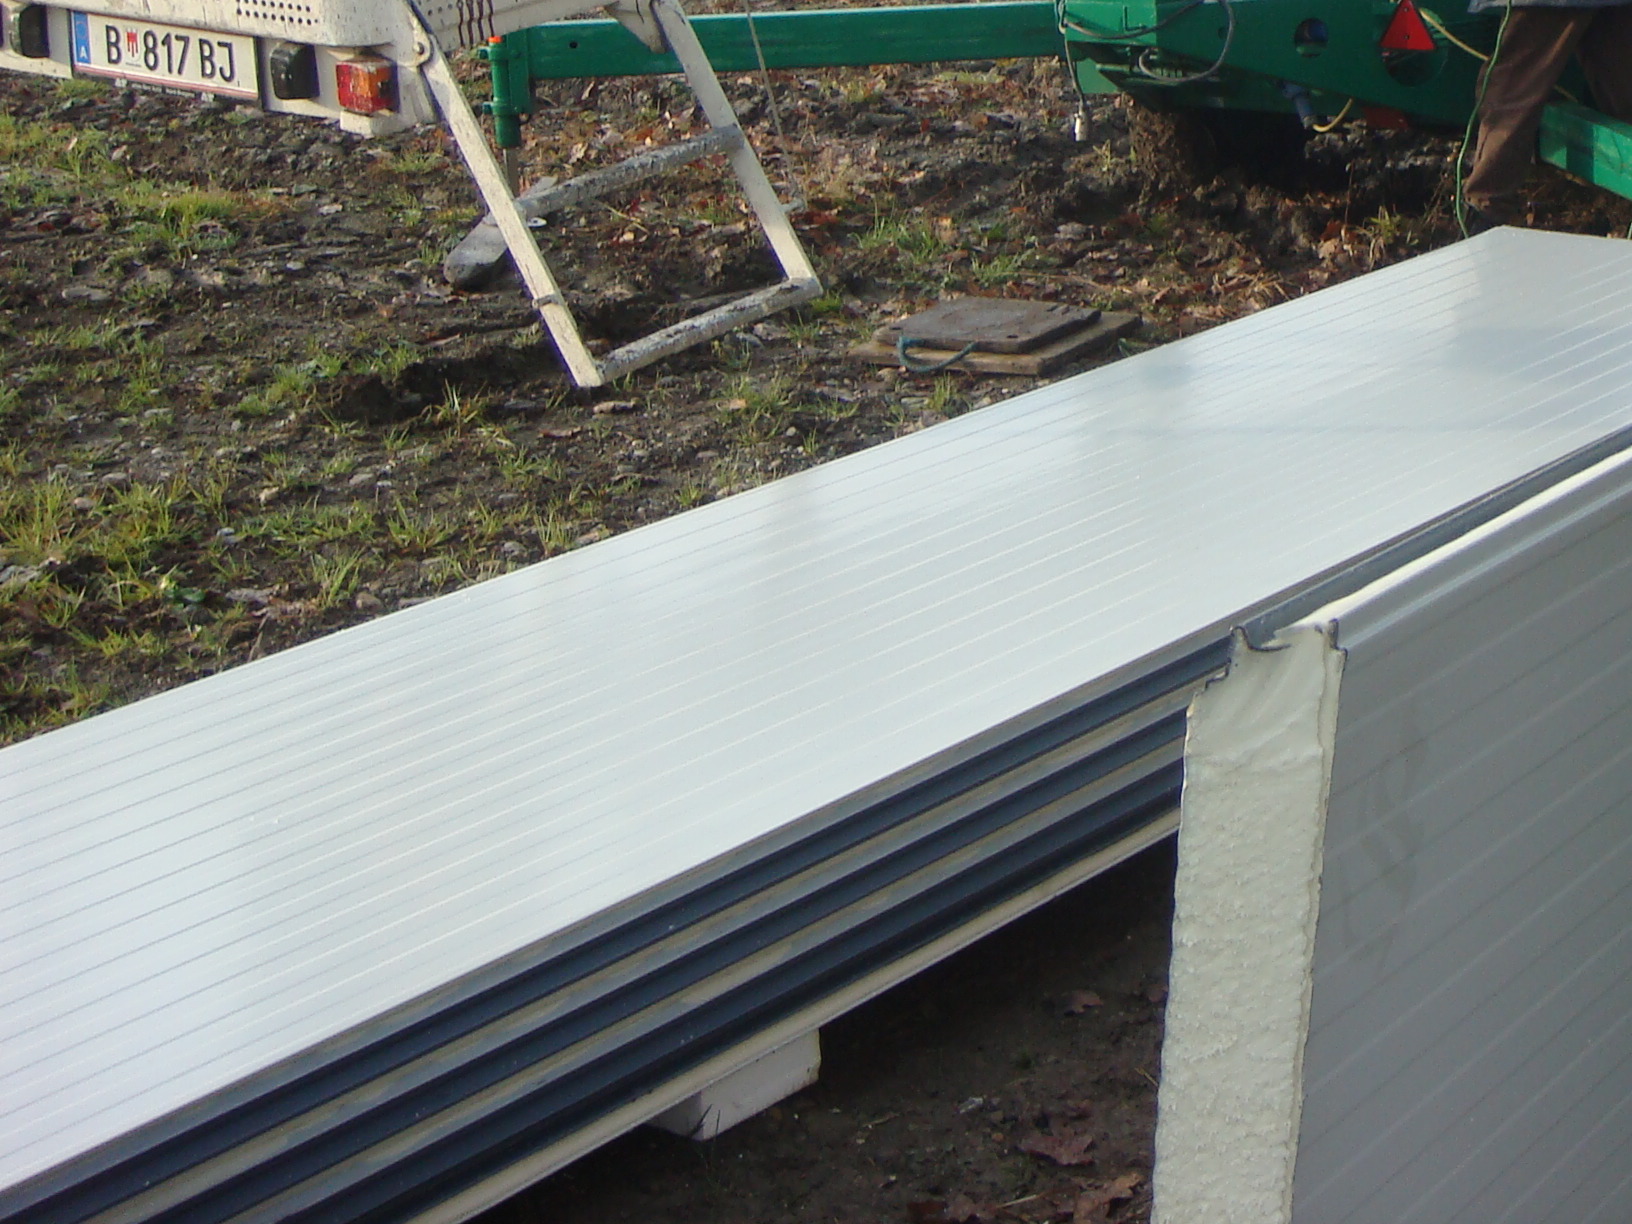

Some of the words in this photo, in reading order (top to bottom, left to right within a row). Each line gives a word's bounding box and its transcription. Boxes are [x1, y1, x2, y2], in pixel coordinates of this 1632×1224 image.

[105, 24, 122, 65] B
[143, 29, 190, 76] 817
[199, 38, 235, 83] BJ
